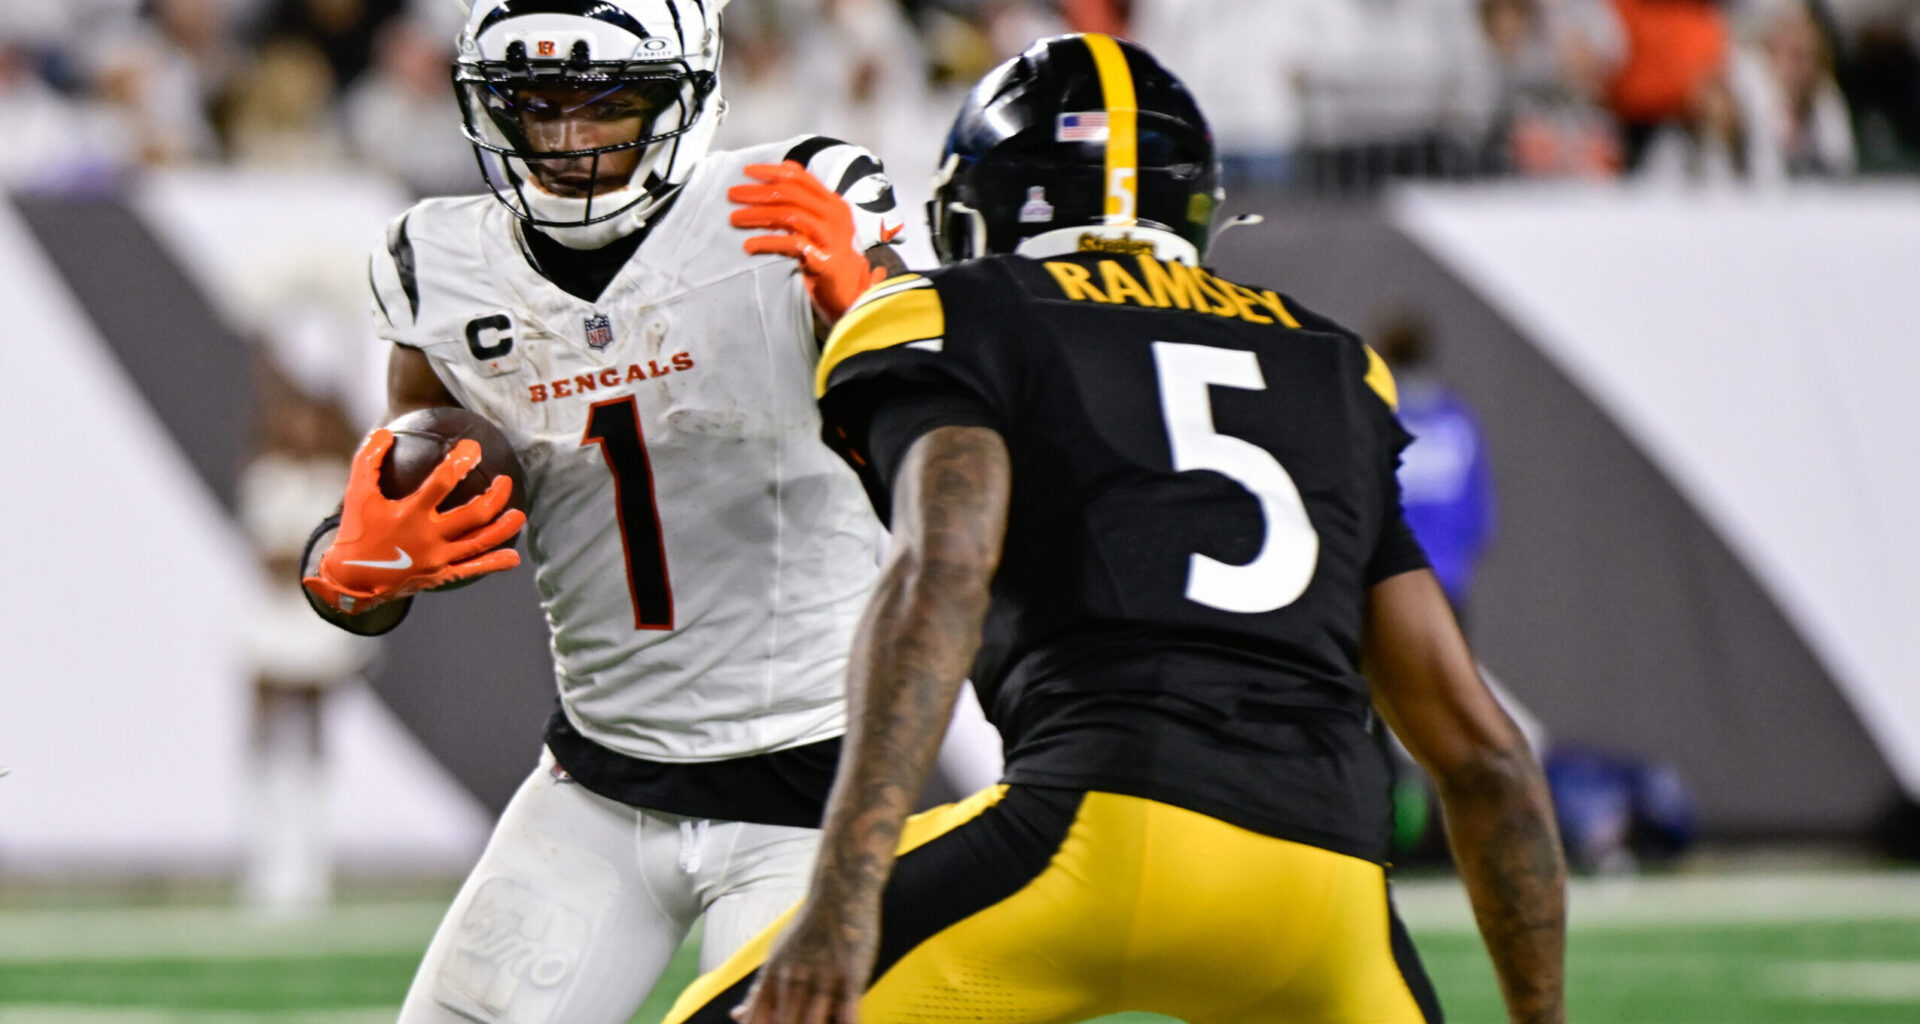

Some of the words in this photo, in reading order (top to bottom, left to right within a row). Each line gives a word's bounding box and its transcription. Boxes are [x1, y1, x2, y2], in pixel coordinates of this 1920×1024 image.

[1105, 167, 1136, 224] 5
[1043, 249, 1303, 329] RAMSEY
[466, 313, 513, 361] C
[529, 351, 695, 403] BENGALS
[1152, 340, 1320, 614] 5
[580, 393, 675, 631] 1
